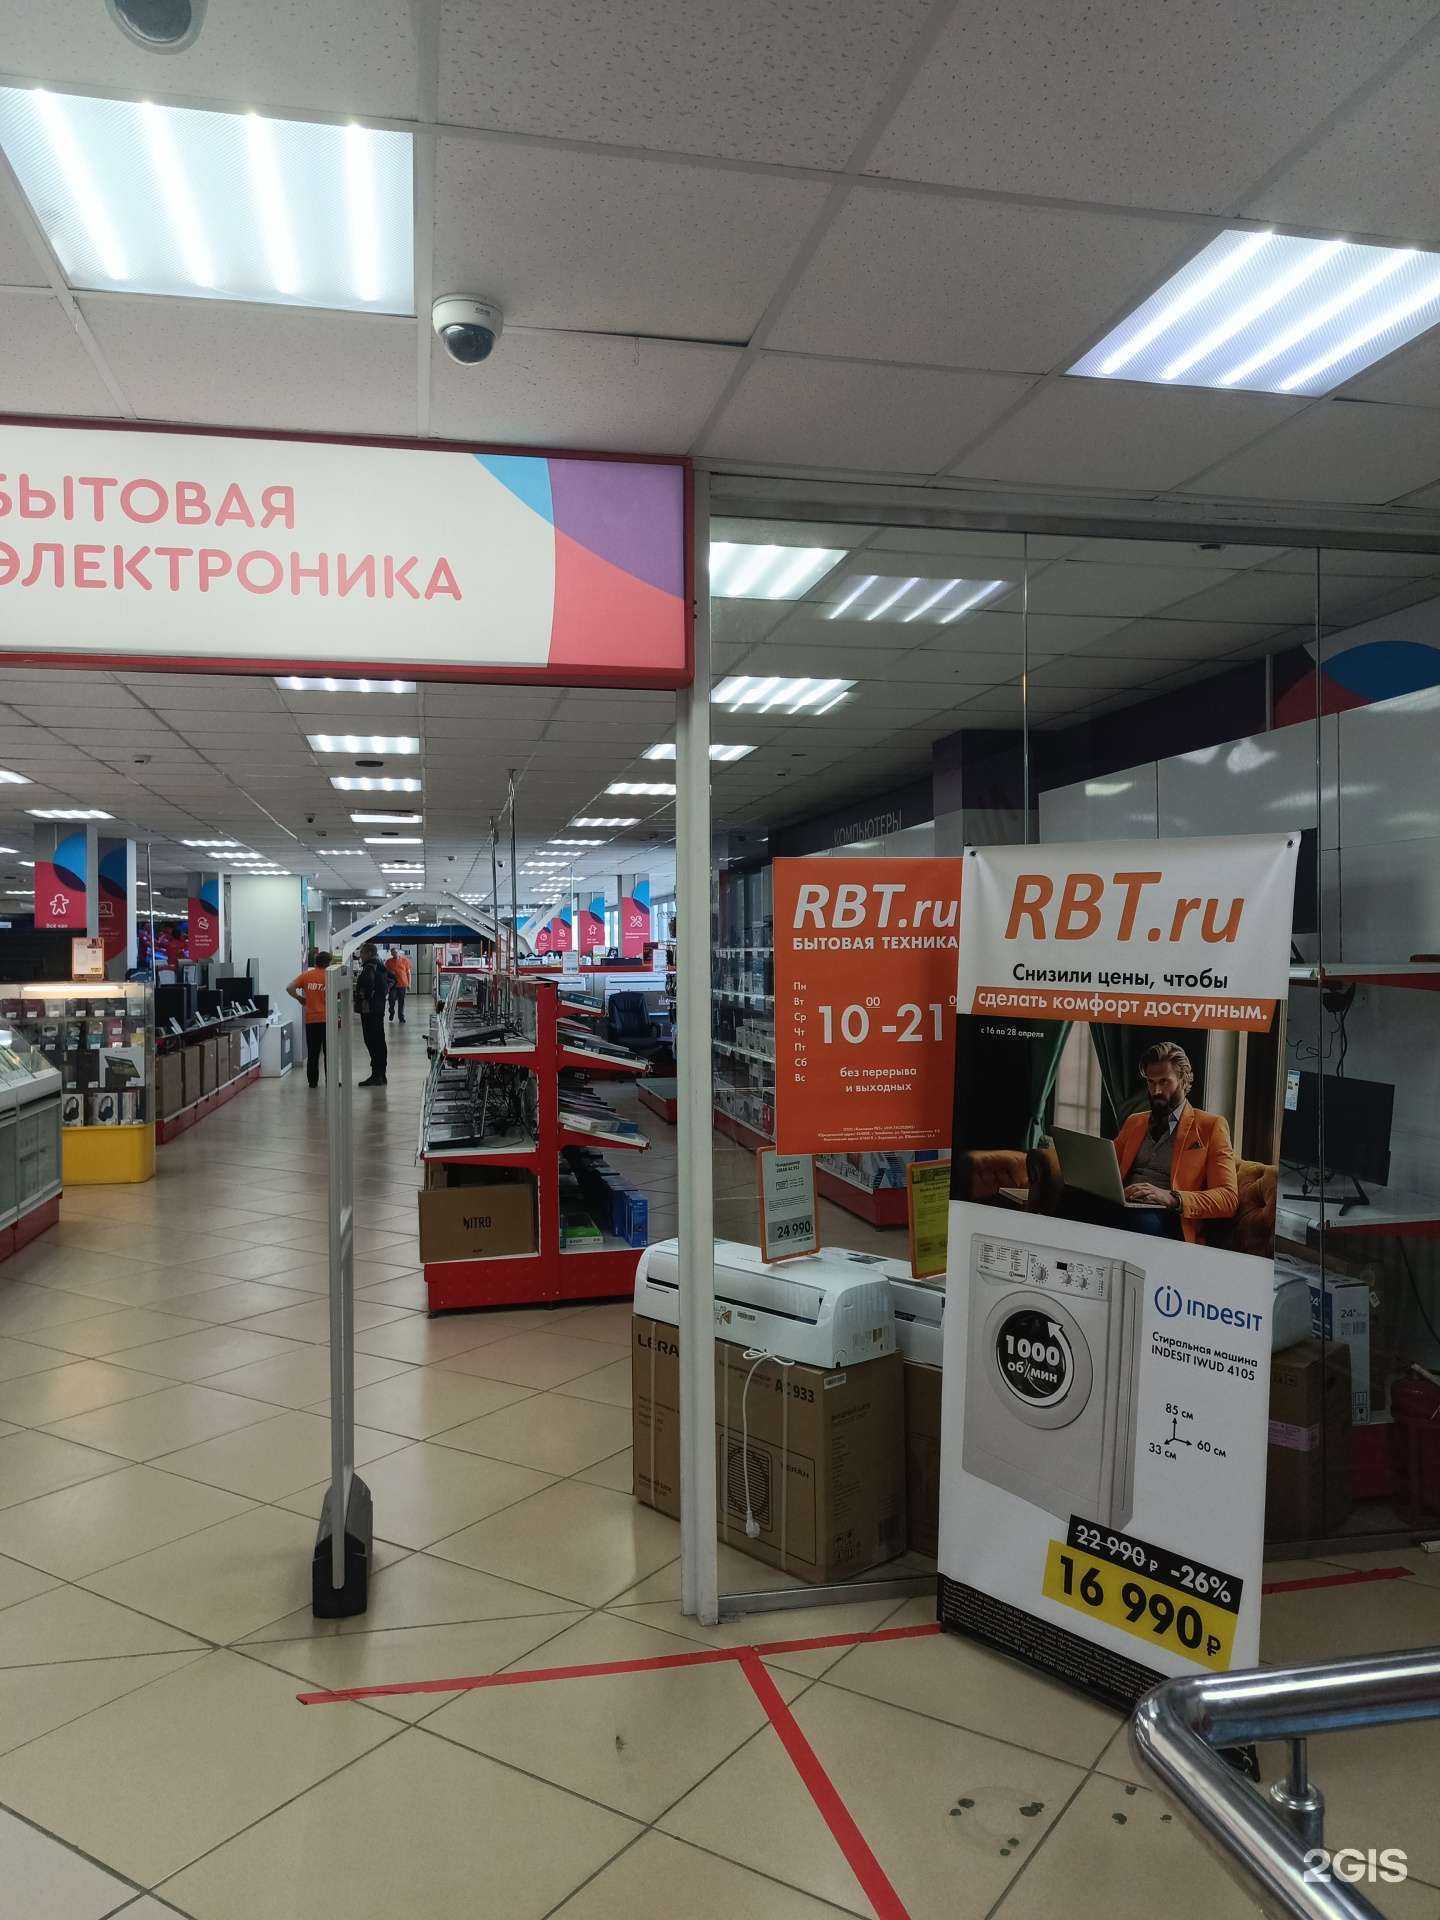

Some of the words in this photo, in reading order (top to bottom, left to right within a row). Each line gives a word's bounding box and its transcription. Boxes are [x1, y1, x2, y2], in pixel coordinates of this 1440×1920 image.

[0, 541, 462, 600] ЭЛЕКТРОНИКА
[793, 884, 958, 928] RBT.ru
[1004, 871, 1245, 943] RBT.ru
[793, 936, 874, 950] БЫТОВАЯ
[881, 935, 959, 949] ТЕХНИКА
[1013, 963, 1092, 983] Снизили
[1098, 970, 1155, 990] цены,
[1163, 968, 1228, 989] чтобы
[793, 982, 807, 990] Пн
[794, 997, 804, 1006] Вт
[978, 992, 1048, 1008] сделать
[1053, 993, 1139, 1017] комфорт
[1144, 1000, 1268, 1022] доступным.
[794, 1013, 807, 1023] Ср
[818, 1004, 870, 1044] 10
[794, 1028, 805, 1036] Чт
[986, 1026, 995, 1034] 16
[1007, 1028, 1017, 1036] 28
[794, 1043, 806, 1051] Пт
[795, 1058, 807, 1066] Сб
[795, 1074, 805, 1082] Вс
[840, 1067, 860, 1077] без
[862, 1068, 917, 1078] перерыва
[855, 1083, 912, 1093] выходных
[1006, 1334, 1060, 1366] 1000
[1152, 1331, 1211, 1356] Стиральная
[1213, 1350, 1258, 1367] машина
[1151, 1344, 1191, 1363] INDESIT
[1193, 1355, 1225, 1373] IWUD
[1227, 1365, 1255, 1381] 4105
[1007, 1361, 1058, 1383] об/мин
[1165, 1403, 1179, 1415] 85
[1181, 1410, 1193, 1420] см
[1148, 1442, 1162, 1455] 33
[1164, 1449, 1177, 1461] см
[1197, 1440, 1211, 1453] 60
[1213, 1447, 1226, 1458] см
[1076, 1525, 1101, 1550] 22
[1106, 1536, 1145, 1567] 990
[1170, 1564, 1231, 1603] -26%
[1060, 1555, 1104, 1607] 16
